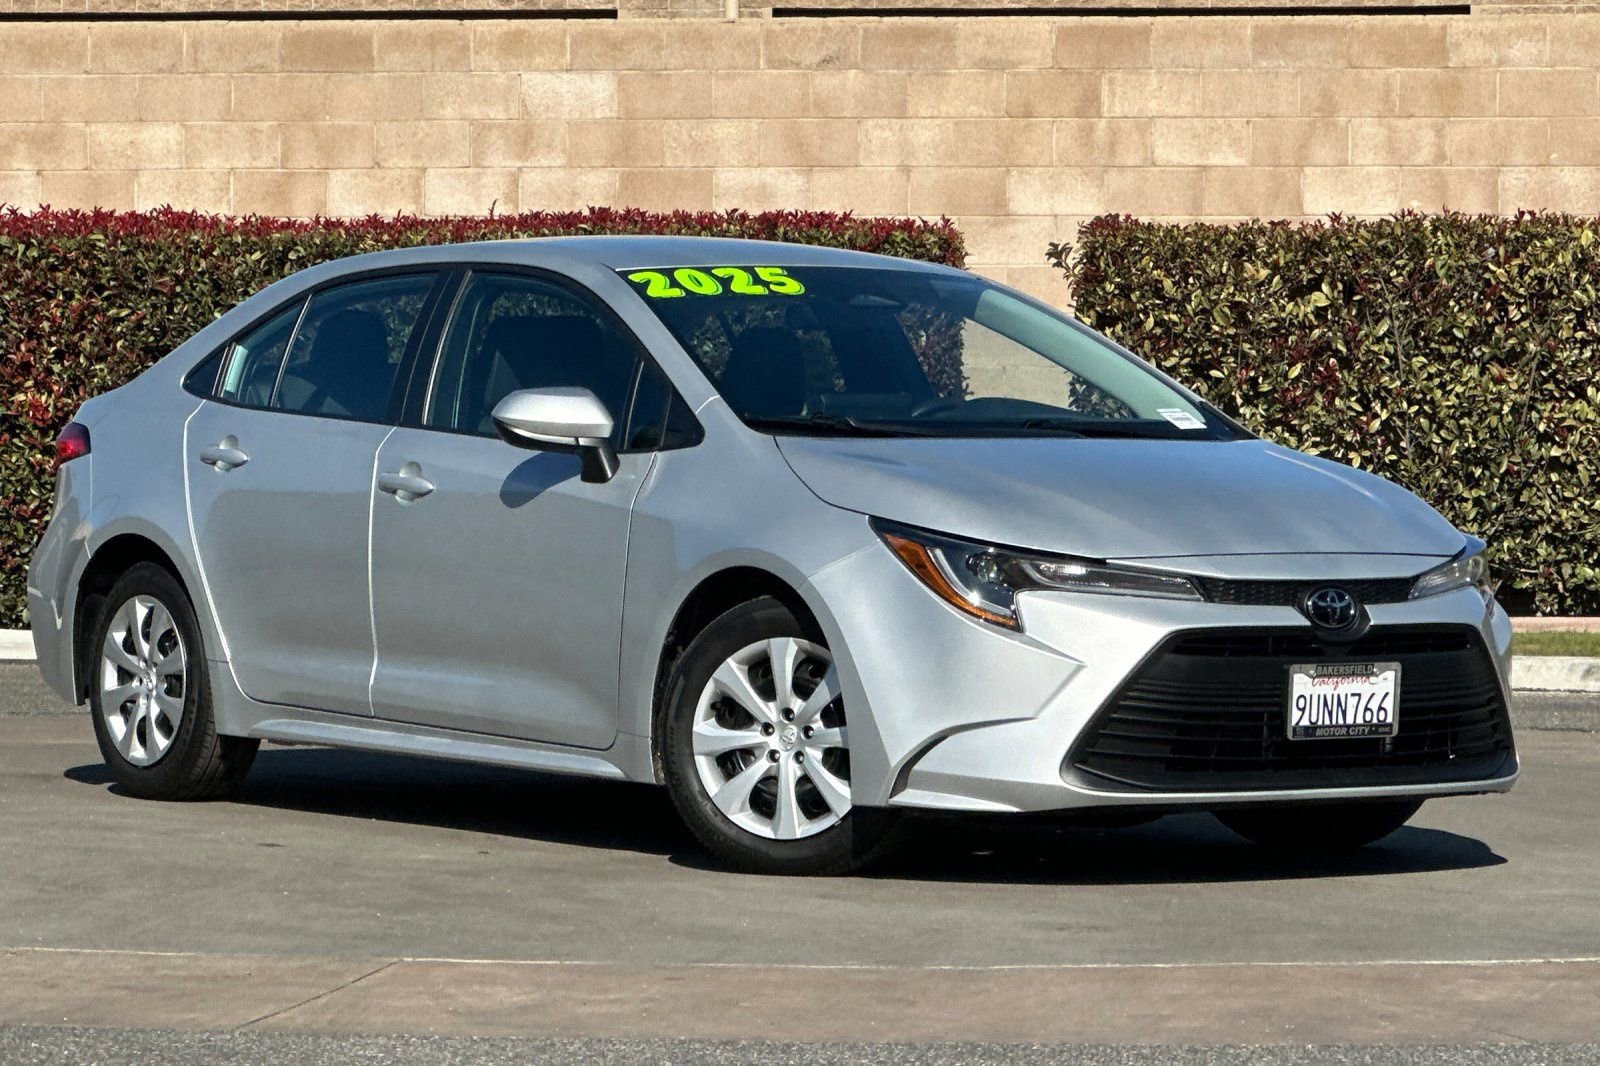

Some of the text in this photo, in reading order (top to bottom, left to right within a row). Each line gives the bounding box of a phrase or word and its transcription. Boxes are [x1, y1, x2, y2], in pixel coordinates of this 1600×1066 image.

[627, 267, 805, 298] 2025
[1316, 665, 1373, 676] BAKERSFIELD
[1295, 692, 1390, 726] 9UNN766
[1315, 727, 1348, 737] MOTOR
[1348, 726, 1370, 736] CITY
